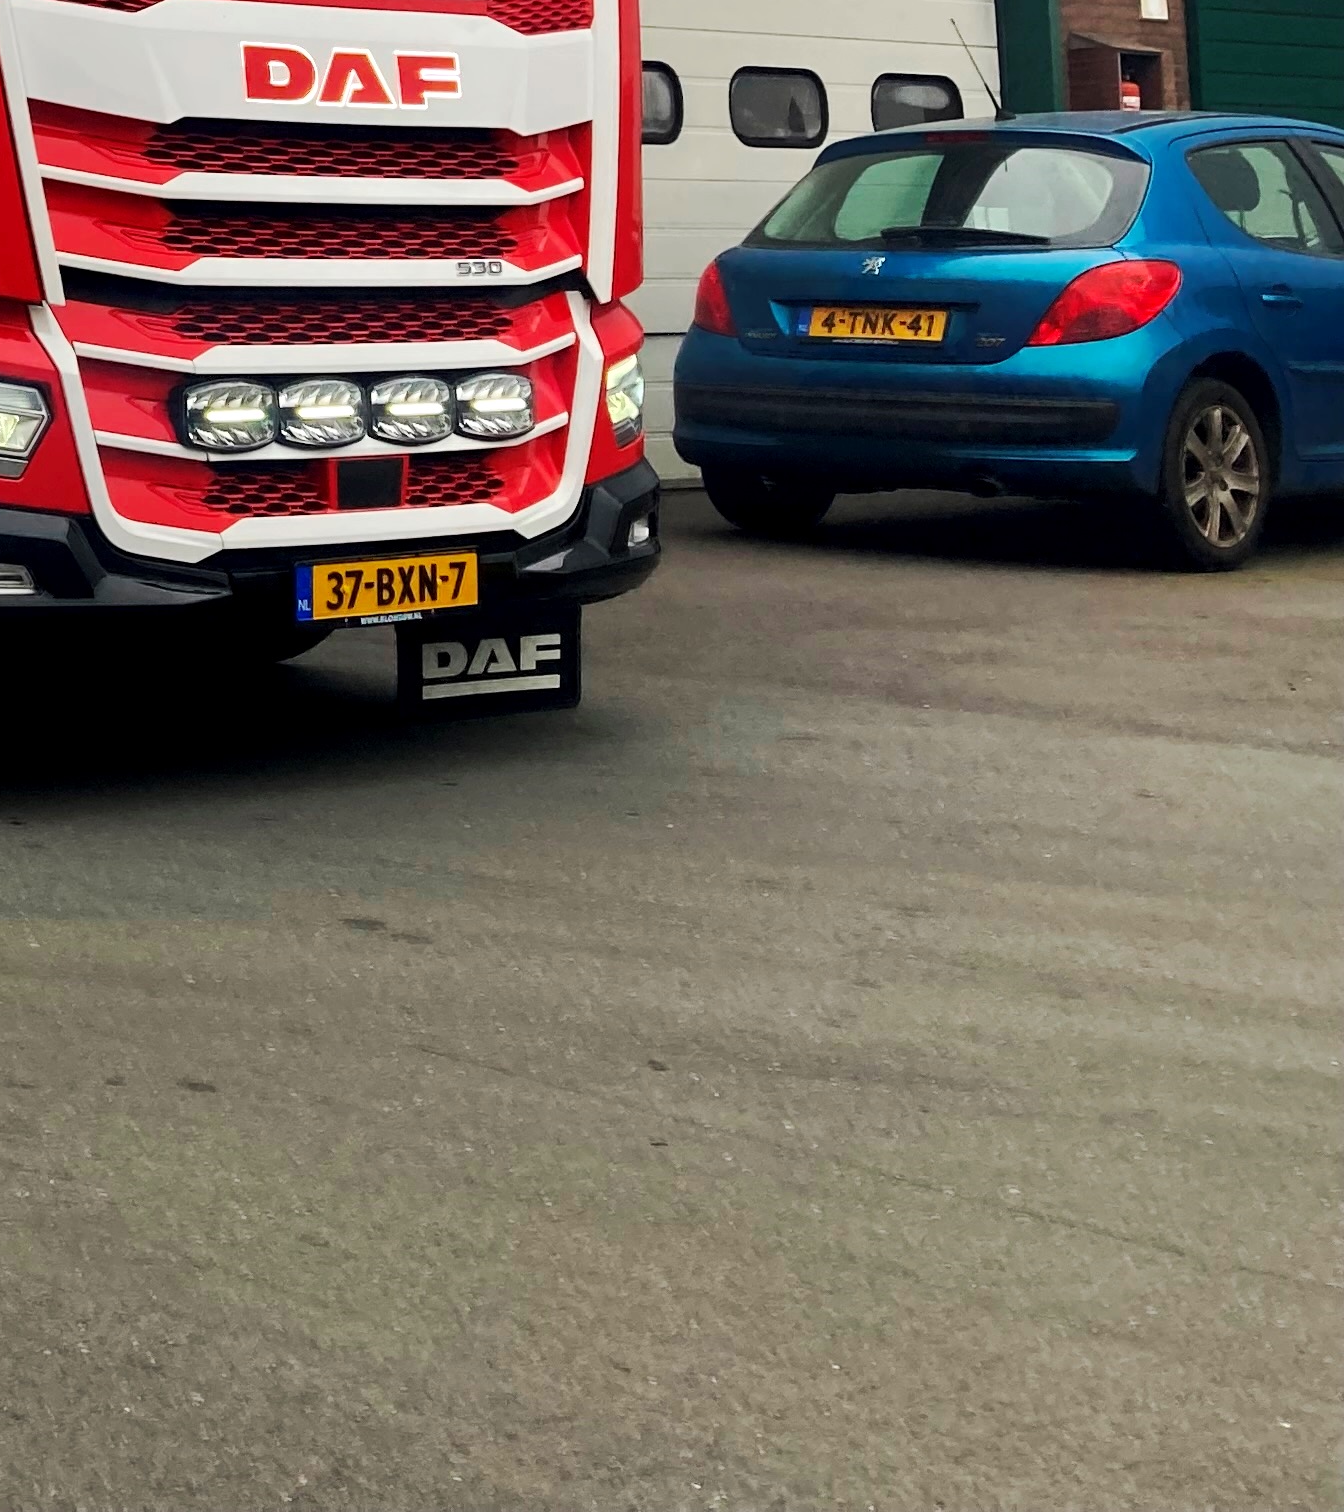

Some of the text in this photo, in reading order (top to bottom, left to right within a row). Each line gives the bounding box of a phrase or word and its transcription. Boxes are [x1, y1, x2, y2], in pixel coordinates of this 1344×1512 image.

[241, 41, 461, 109] DAF
[456, 261, 503, 277] 530
[820, 310, 935, 337] 4-TNK-41
[297, 562, 467, 612] NL 37-BXN-7
[422, 633, 561, 679] DAF
